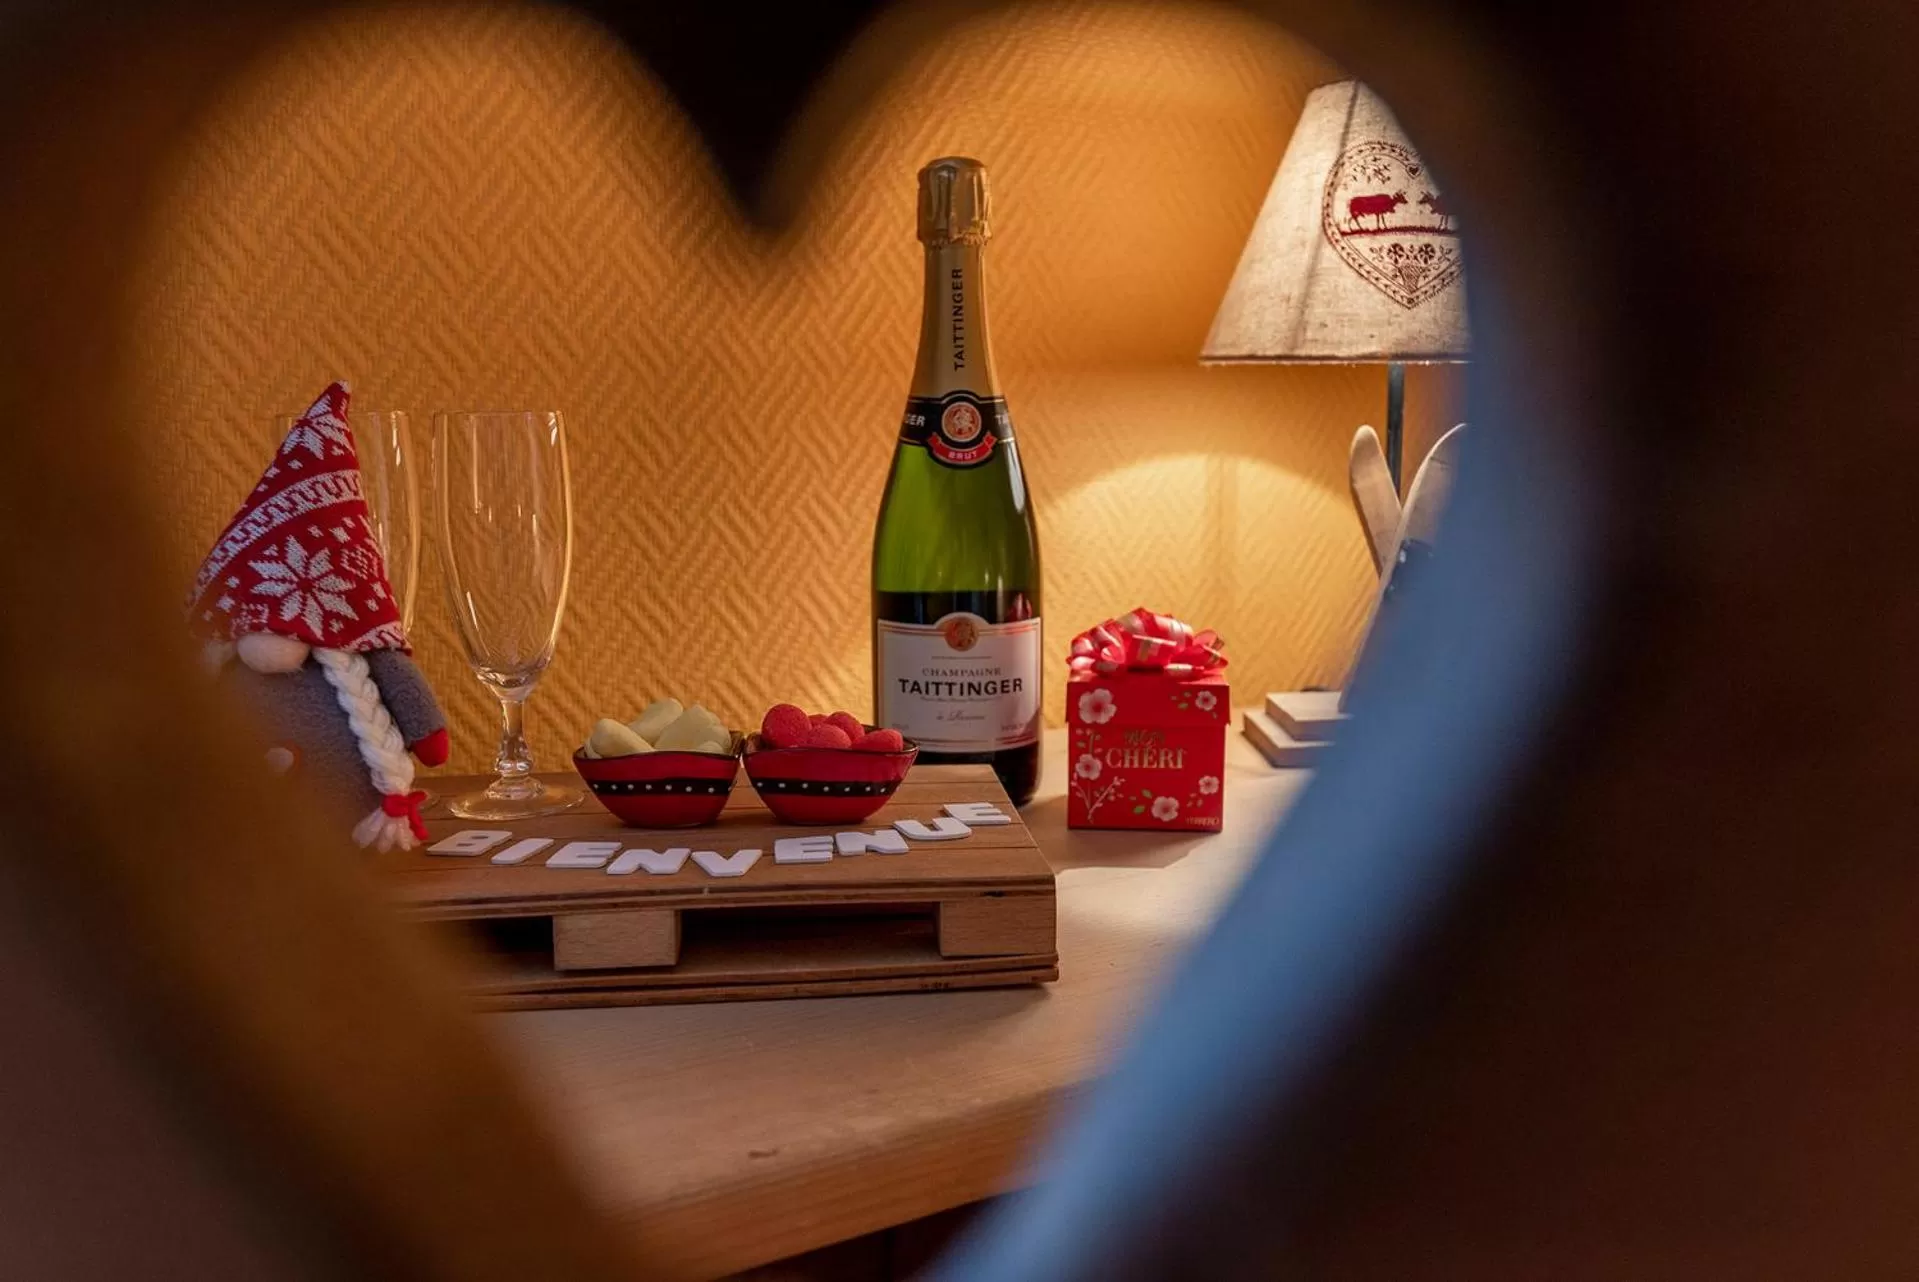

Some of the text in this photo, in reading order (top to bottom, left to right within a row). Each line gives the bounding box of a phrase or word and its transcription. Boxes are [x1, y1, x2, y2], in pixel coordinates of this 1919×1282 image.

[952, 268, 964, 371] TAITTINGER
[947, 450, 978, 460] BRUT
[922, 667, 1002, 677] CHAMPAGNE
[898, 678, 1022, 697] TAITTINGER
[426, 801, 1012, 877] BIENVENUE
